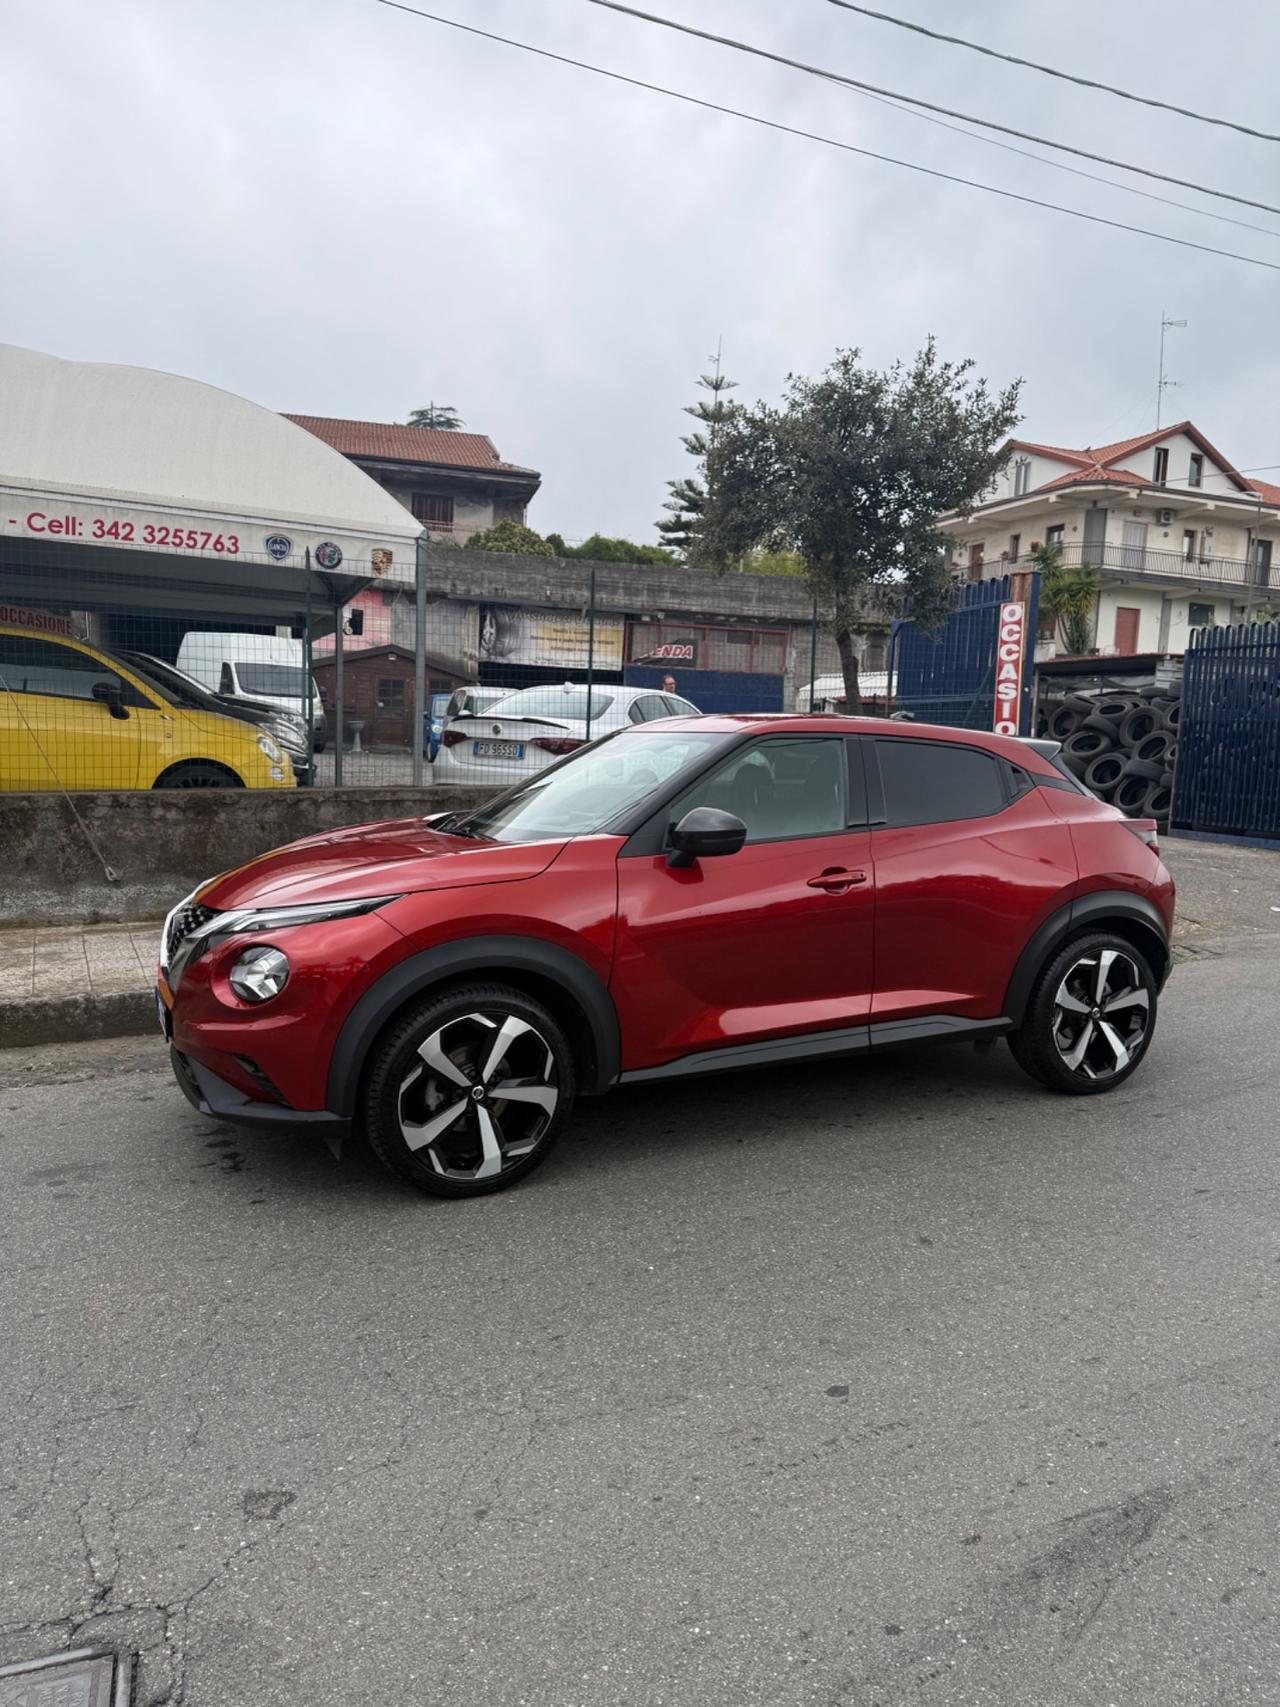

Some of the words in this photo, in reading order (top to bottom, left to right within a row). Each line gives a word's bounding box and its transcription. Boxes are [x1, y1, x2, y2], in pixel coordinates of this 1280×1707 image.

[26, 512, 83, 537] Cell:
[91, 518, 135, 542] 342
[142, 524, 240, 555] 3255763
[0, 605, 72, 635] OCCASIONE
[995, 604, 1022, 736] OCCASIO
